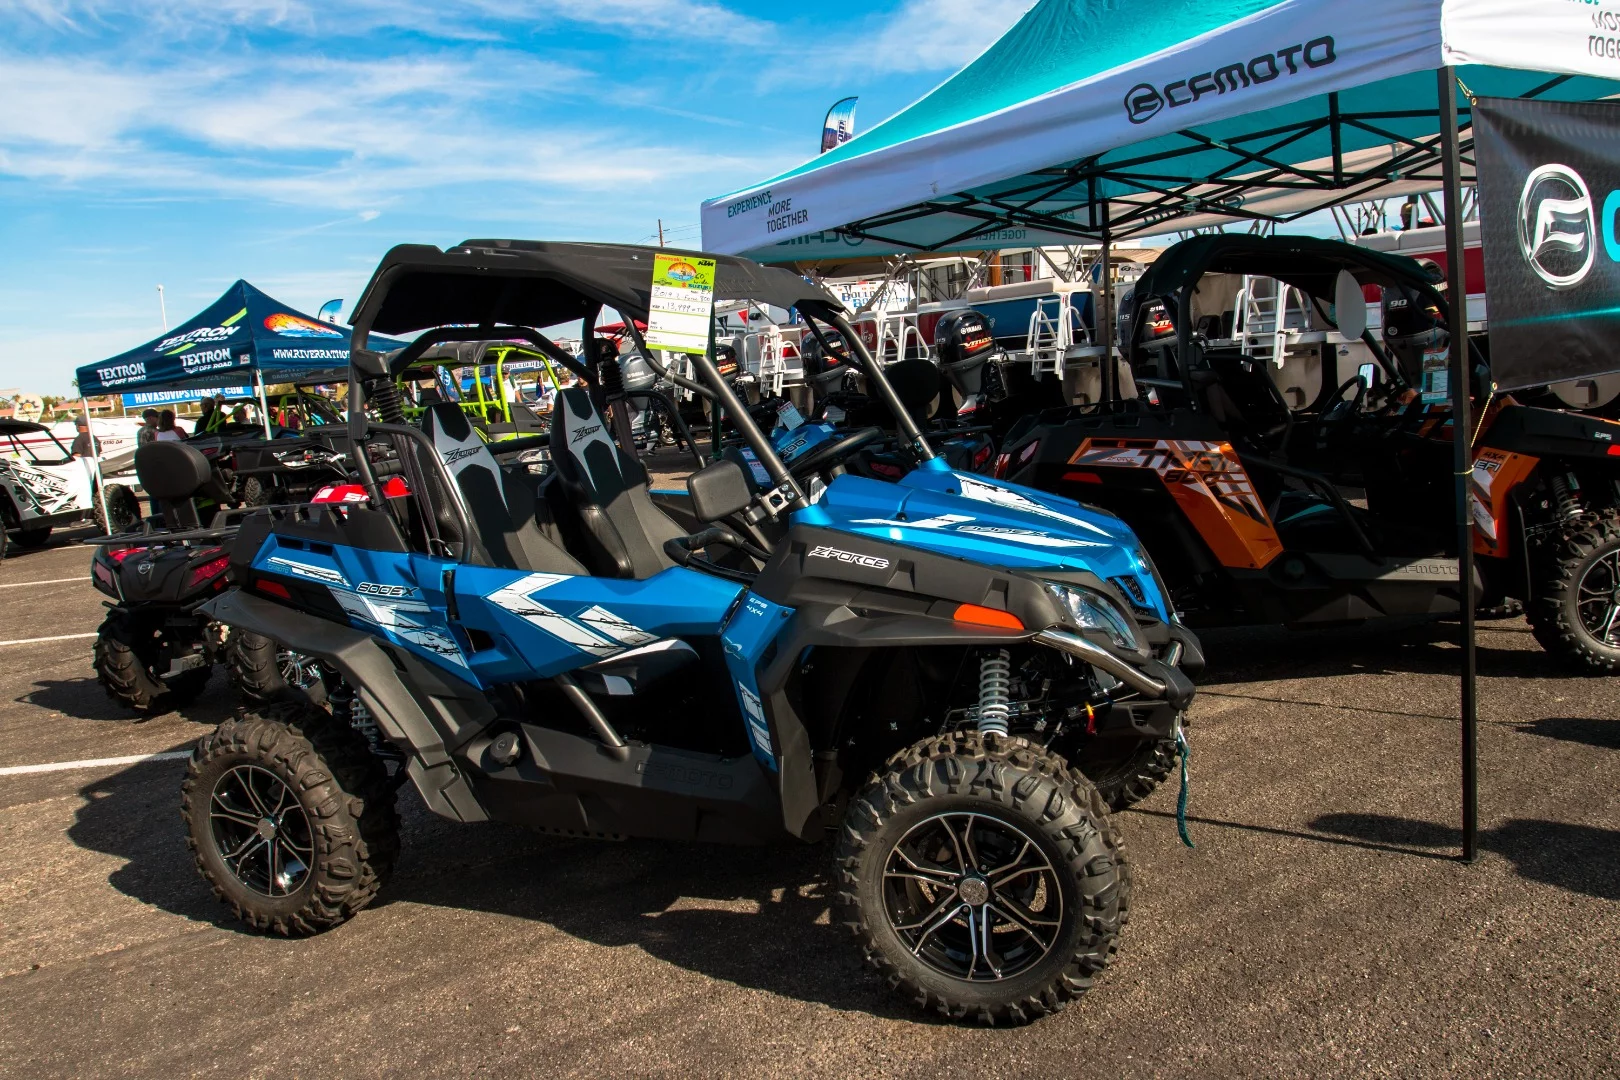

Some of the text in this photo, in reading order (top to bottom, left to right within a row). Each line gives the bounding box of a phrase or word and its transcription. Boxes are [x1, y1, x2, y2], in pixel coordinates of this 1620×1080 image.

[1163, 35, 1337, 109] CFMOTO
[727, 190, 773, 218] EXPERIENCE
[768, 198, 792, 218] MORE
[767, 209, 809, 234] TOGETHER
[656, 254, 682, 262] Kawasaki
[157, 325, 241, 348] TEXTRON
[180, 348, 231, 367] TEXTRON
[199, 360, 233, 372] OFF ROAD
[97, 362, 146, 381] TEXTRON
[114, 374, 147, 385] OFF ROAD
[1475, 459, 1502, 473] EFI
[356, 581, 420, 598] 800EX
[749, 597, 769, 609] EPS
